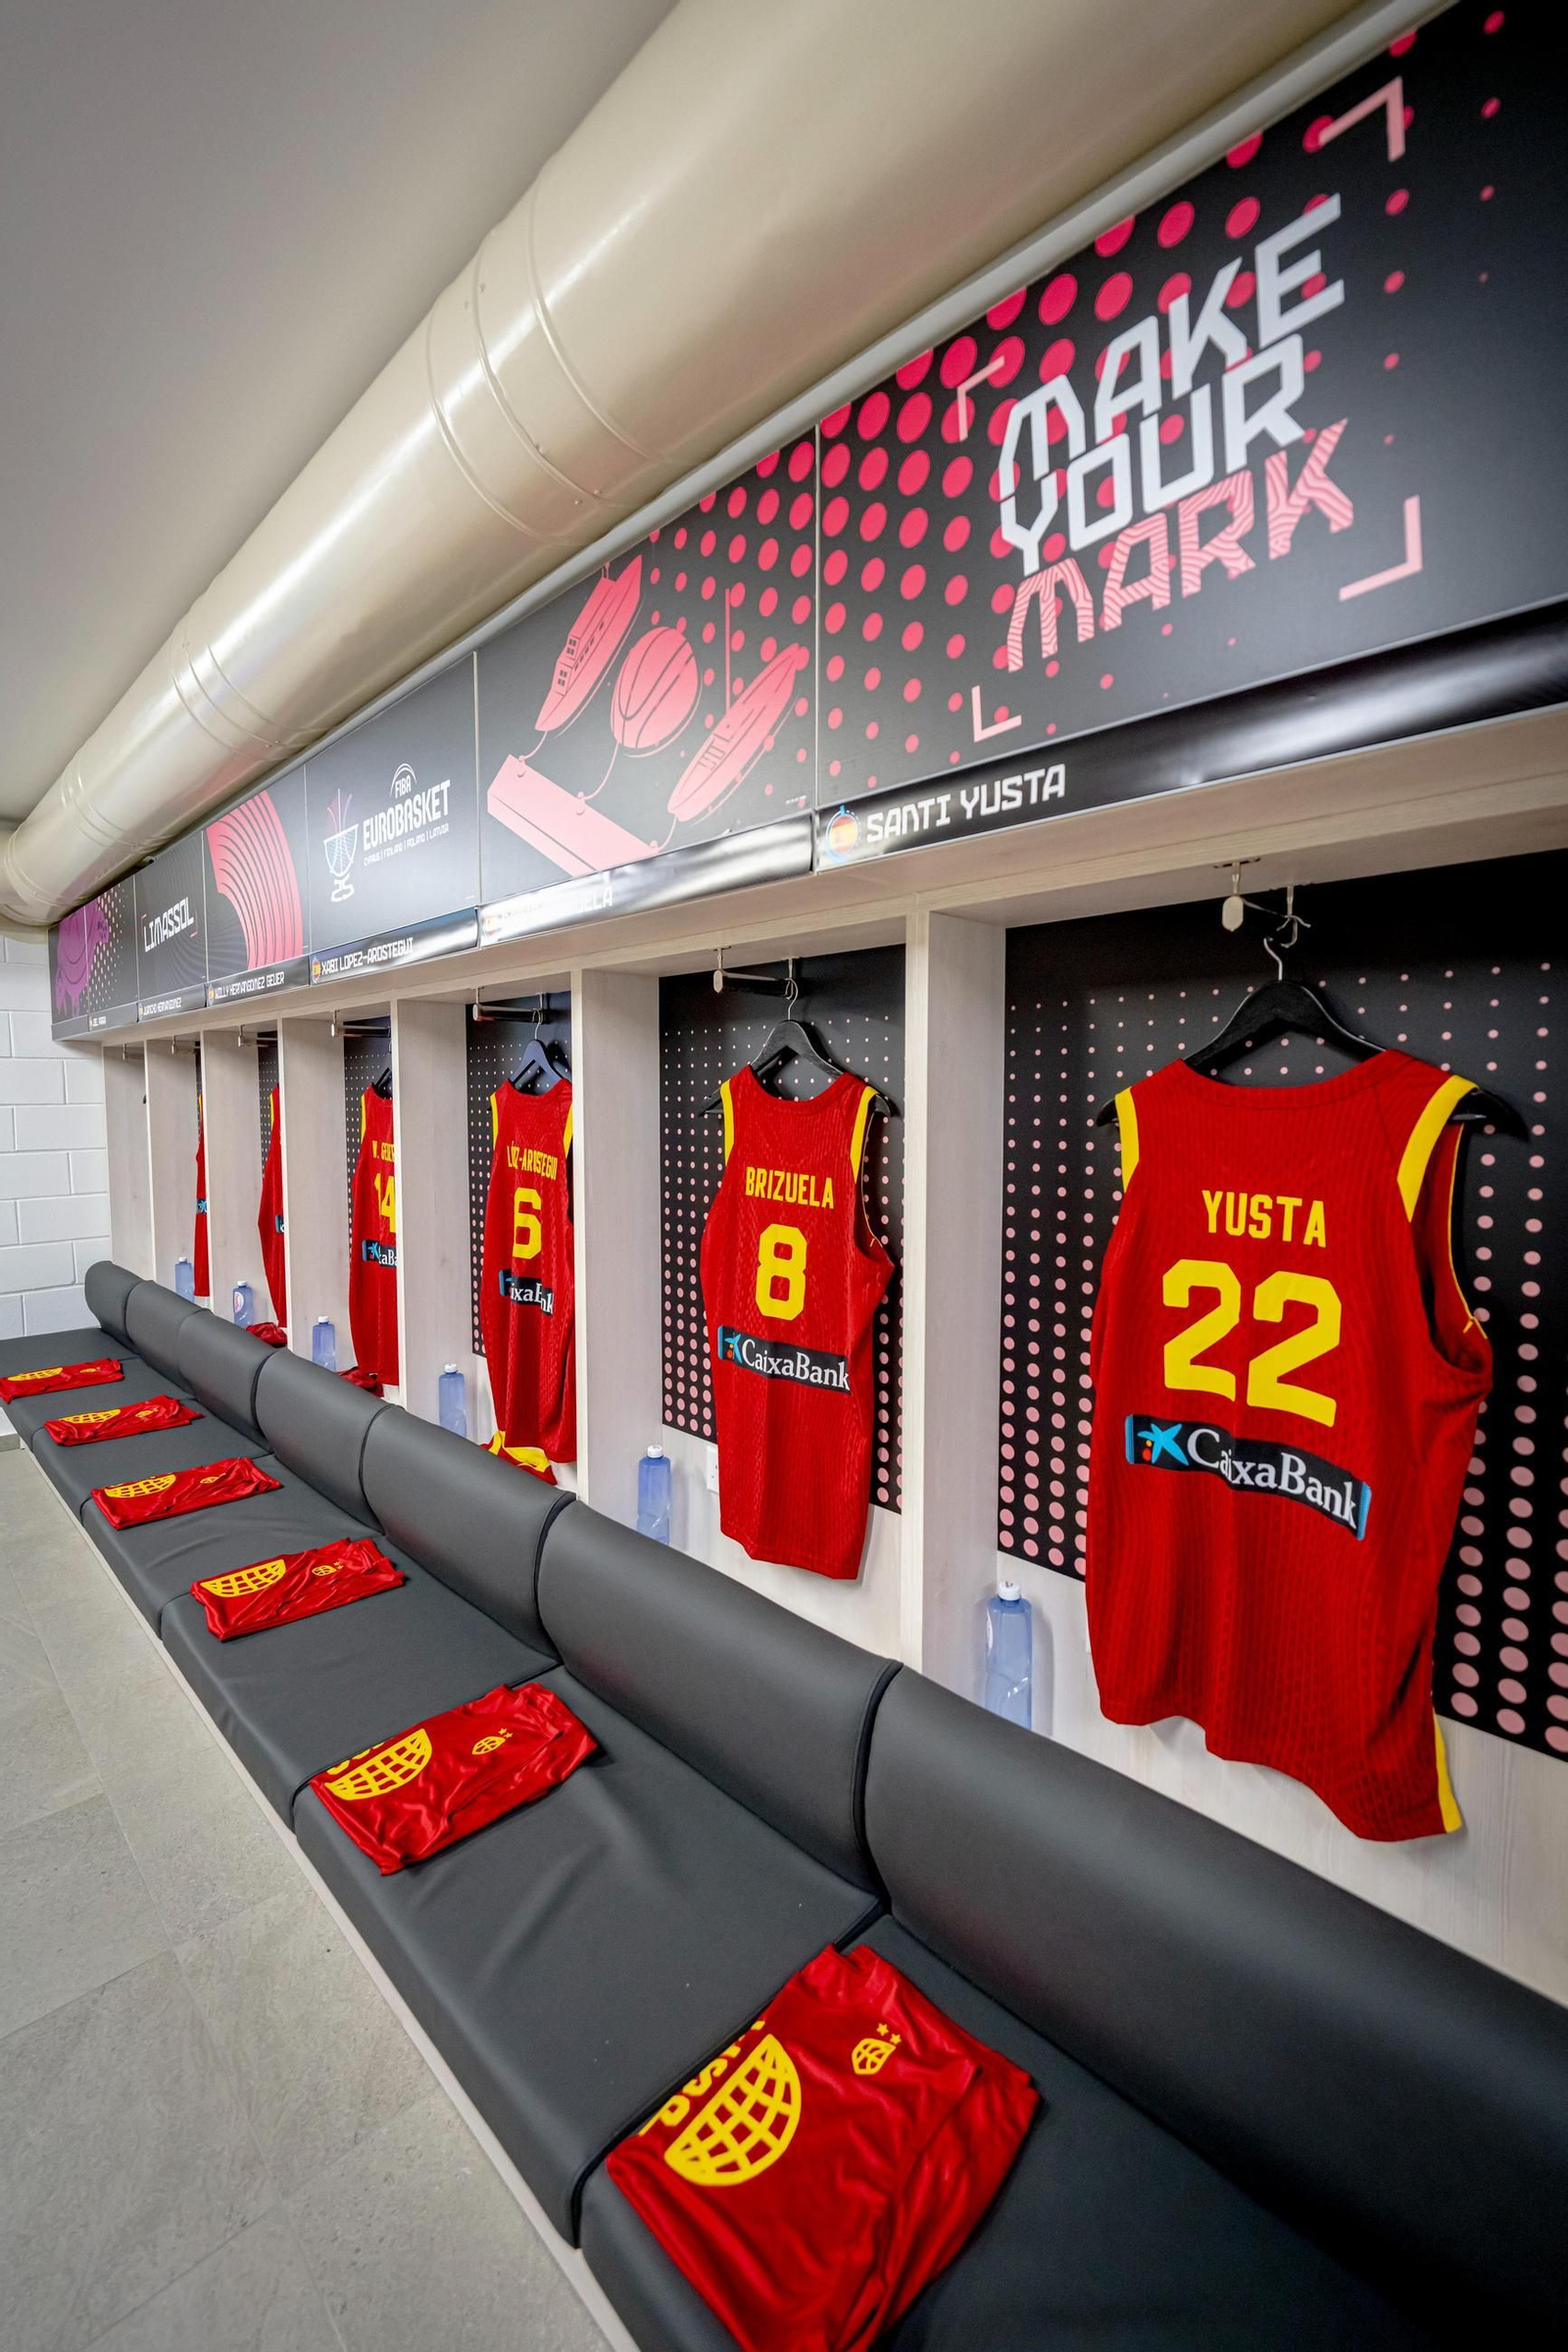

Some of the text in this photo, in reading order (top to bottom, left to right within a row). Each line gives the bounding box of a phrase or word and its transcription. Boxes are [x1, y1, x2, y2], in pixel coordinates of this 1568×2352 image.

[999, 193, 1345, 500] MAKE
[1000, 332, 1305, 576] YOUR
[1007, 418, 1354, 672] MARK
[363, 779, 451, 852] EUROBASKET
[395, 774, 412, 799] FIBA
[866, 763, 1066, 844] SANTI YUSTA
[407, 833, 425, 849] POLAND
[429, 822, 450, 840] LATVIA
[143, 897, 195, 953] LIMASSOL
[320, 937, 414, 976] XABI LOPEZ-AROSTEGUI
[373, 1172, 397, 1234] 14
[512, 1187, 542, 1260] 6
[745, 1166, 835, 1209] BRIZUELA
[1201, 1190, 1327, 1249] YUSTA
[755, 1223, 808, 1321] 8
[741, 1339, 851, 1391] CaixaBank
[1162, 1258, 1342, 1427] 22
[1186, 1427, 1357, 1530] CaixaBank
